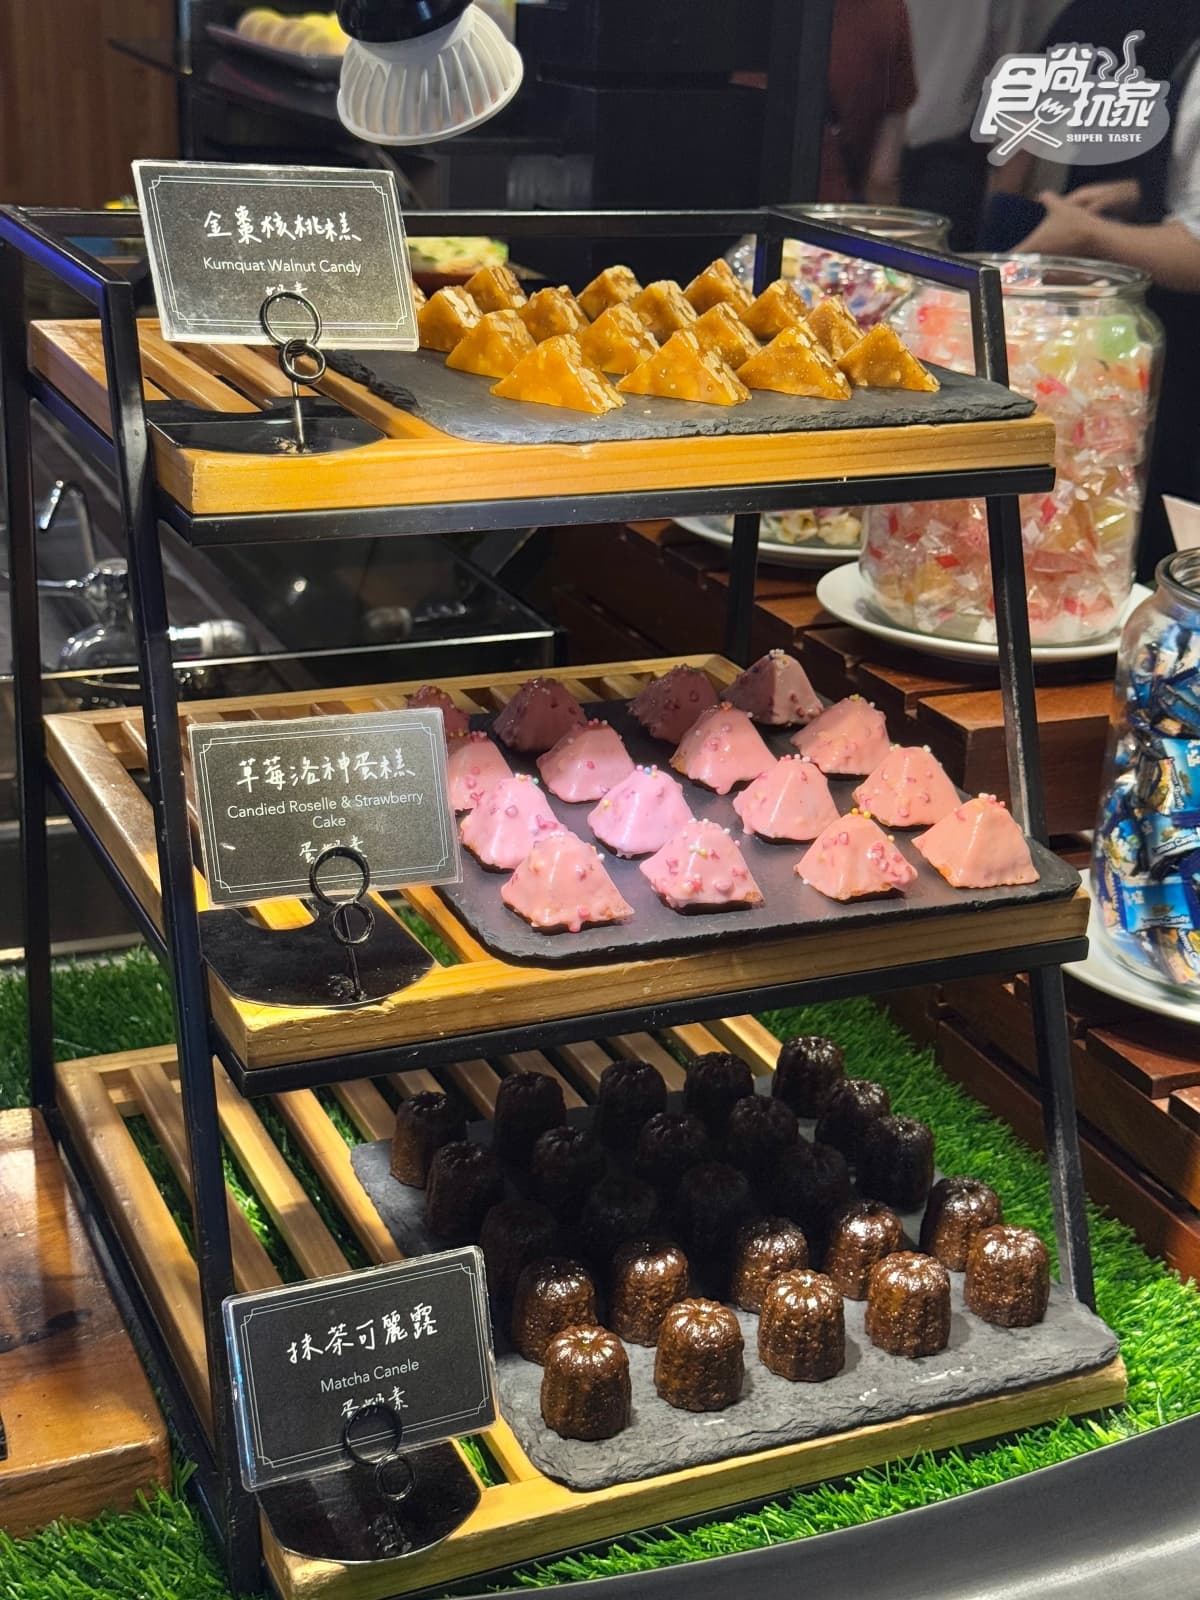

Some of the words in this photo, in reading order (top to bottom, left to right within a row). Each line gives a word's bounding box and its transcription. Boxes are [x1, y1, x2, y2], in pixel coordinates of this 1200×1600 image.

[203, 205, 362, 245] 金棗核桃糕
[203, 257, 266, 273] Kumquat
[267, 258, 316, 273] Walnut
[320, 259, 362, 276] Candy
[236, 748, 416, 793] 草莓洛神蛋糕
[227, 800, 286, 819] Candied
[289, 796, 337, 813] Roselle
[341, 796, 352, 808] &
[355, 791, 424, 808] Strawberry
[312, 815, 346, 829] Cake
[286, 1302, 439, 1365] 抹茶可麗露
[320, 1371, 371, 1393] Matcha
[373, 1359, 420, 1382] Canele
